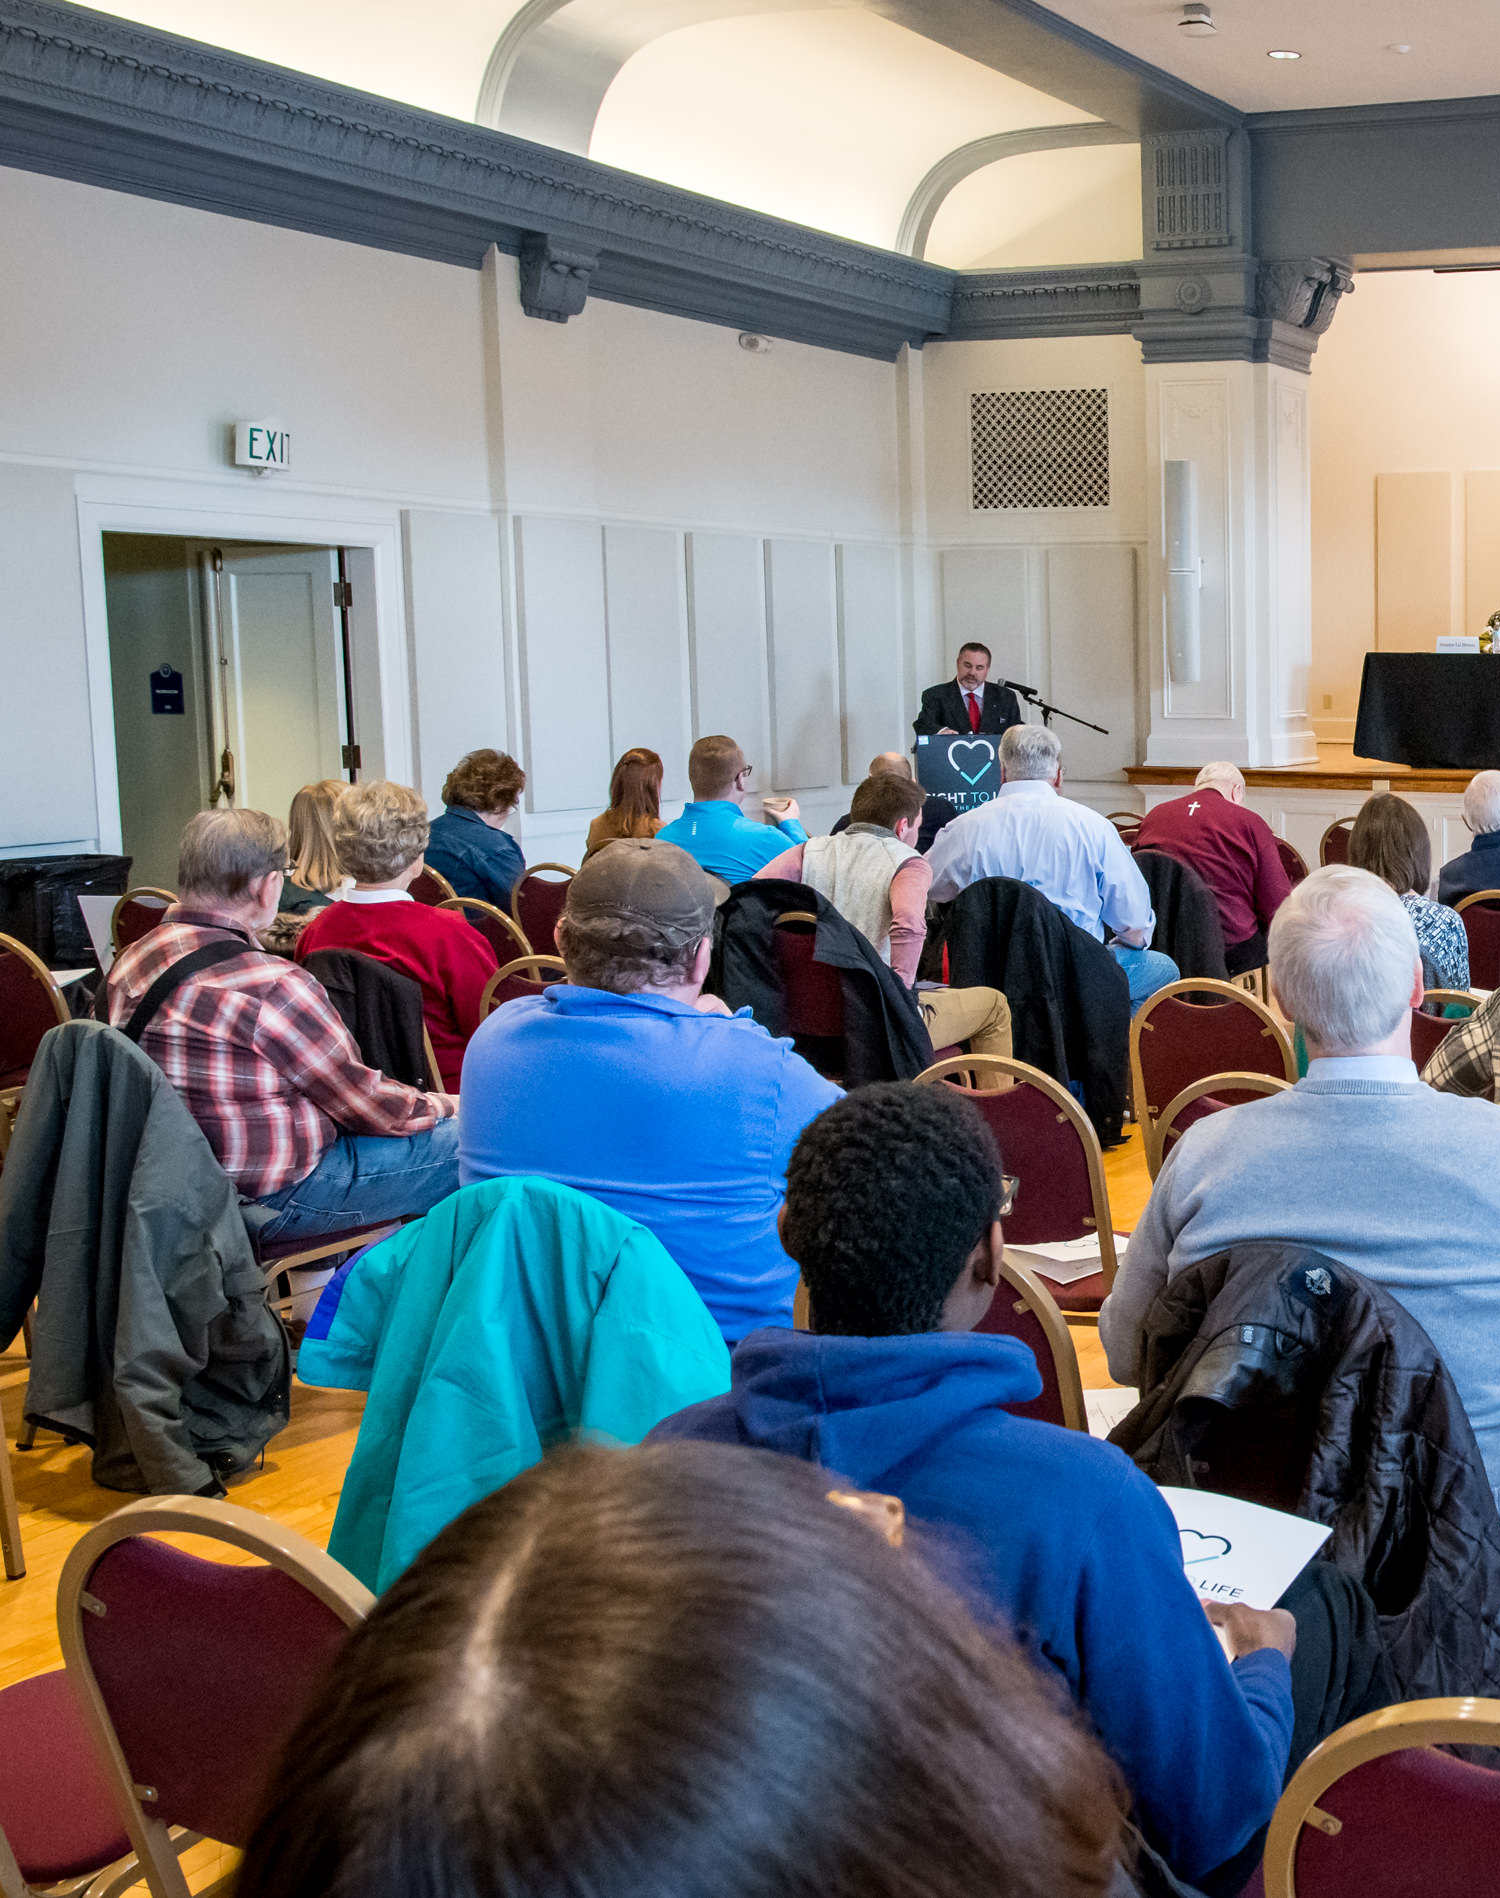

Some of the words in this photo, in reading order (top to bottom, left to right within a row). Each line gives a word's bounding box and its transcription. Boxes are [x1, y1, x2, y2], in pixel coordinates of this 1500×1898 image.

[249, 427, 290, 465] EXIT
[970, 791, 990, 803] TO
[1199, 1579, 1245, 1598] LIFE
